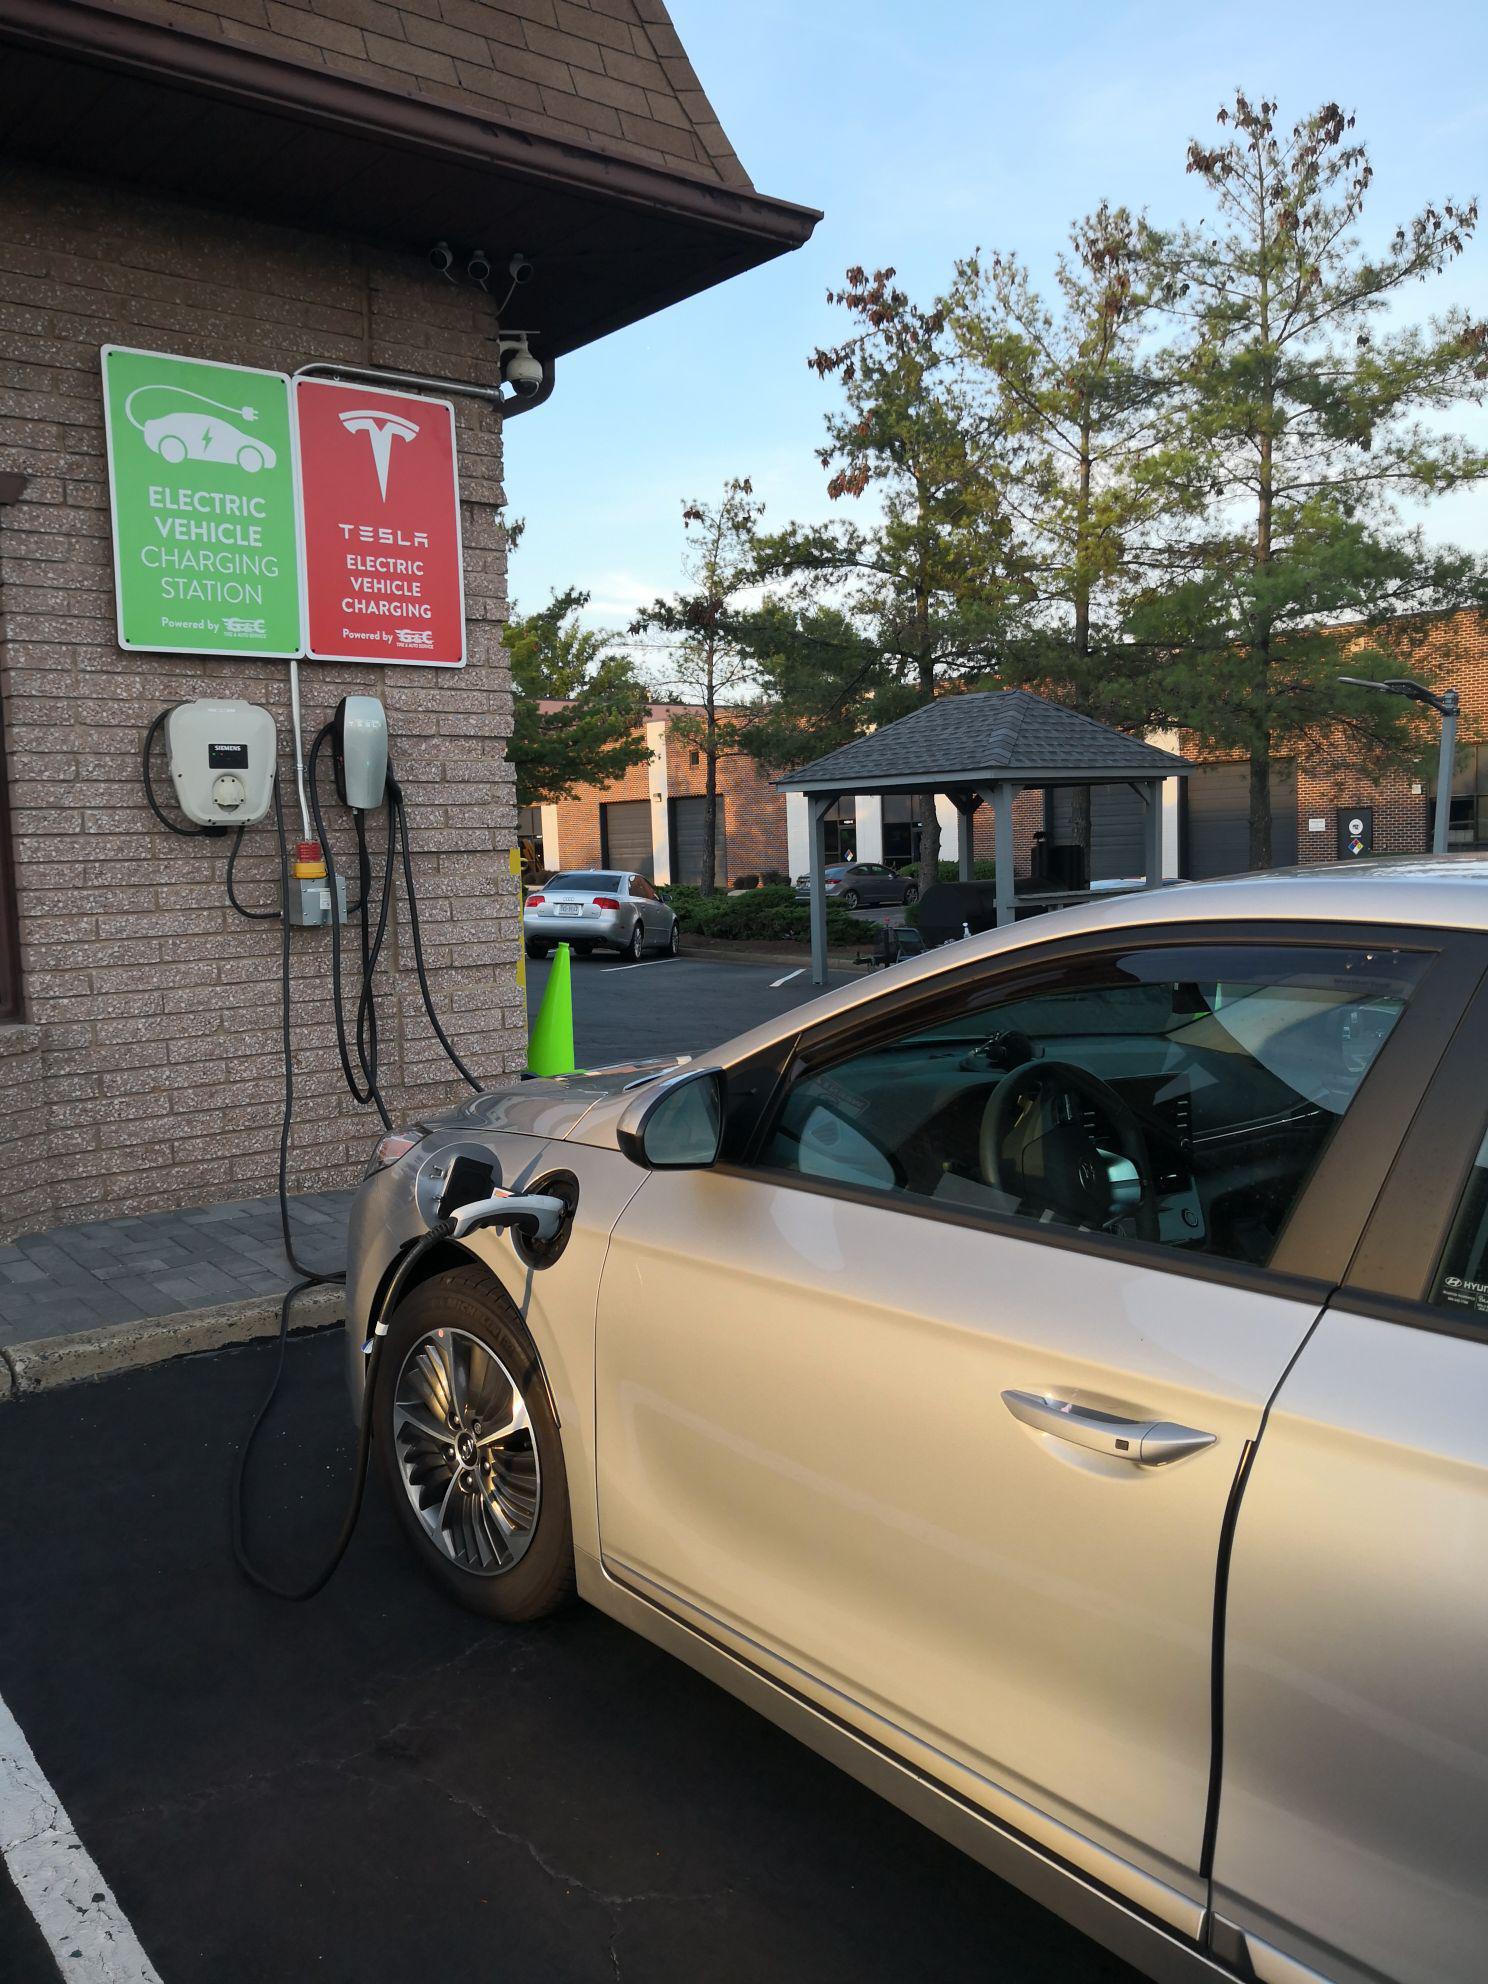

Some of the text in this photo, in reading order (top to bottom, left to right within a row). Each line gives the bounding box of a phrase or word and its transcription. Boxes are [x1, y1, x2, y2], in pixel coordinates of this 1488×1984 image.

[148, 486, 267, 519] ELECTRIC
[153, 516, 263, 547] VEHICLE
[338, 523, 429, 548] TESLA
[140, 545, 279, 577] CHARGING
[346, 554, 424, 576] ELECTRIC
[160, 577, 263, 605] STATION
[350, 576, 422, 597] VEHICLE
[341, 597, 432, 619] CHARGING
[160, 616, 205, 630] Powered
[207, 619, 220, 633] by
[342, 628, 381, 641] Powered
[382, 630, 394, 645] by
